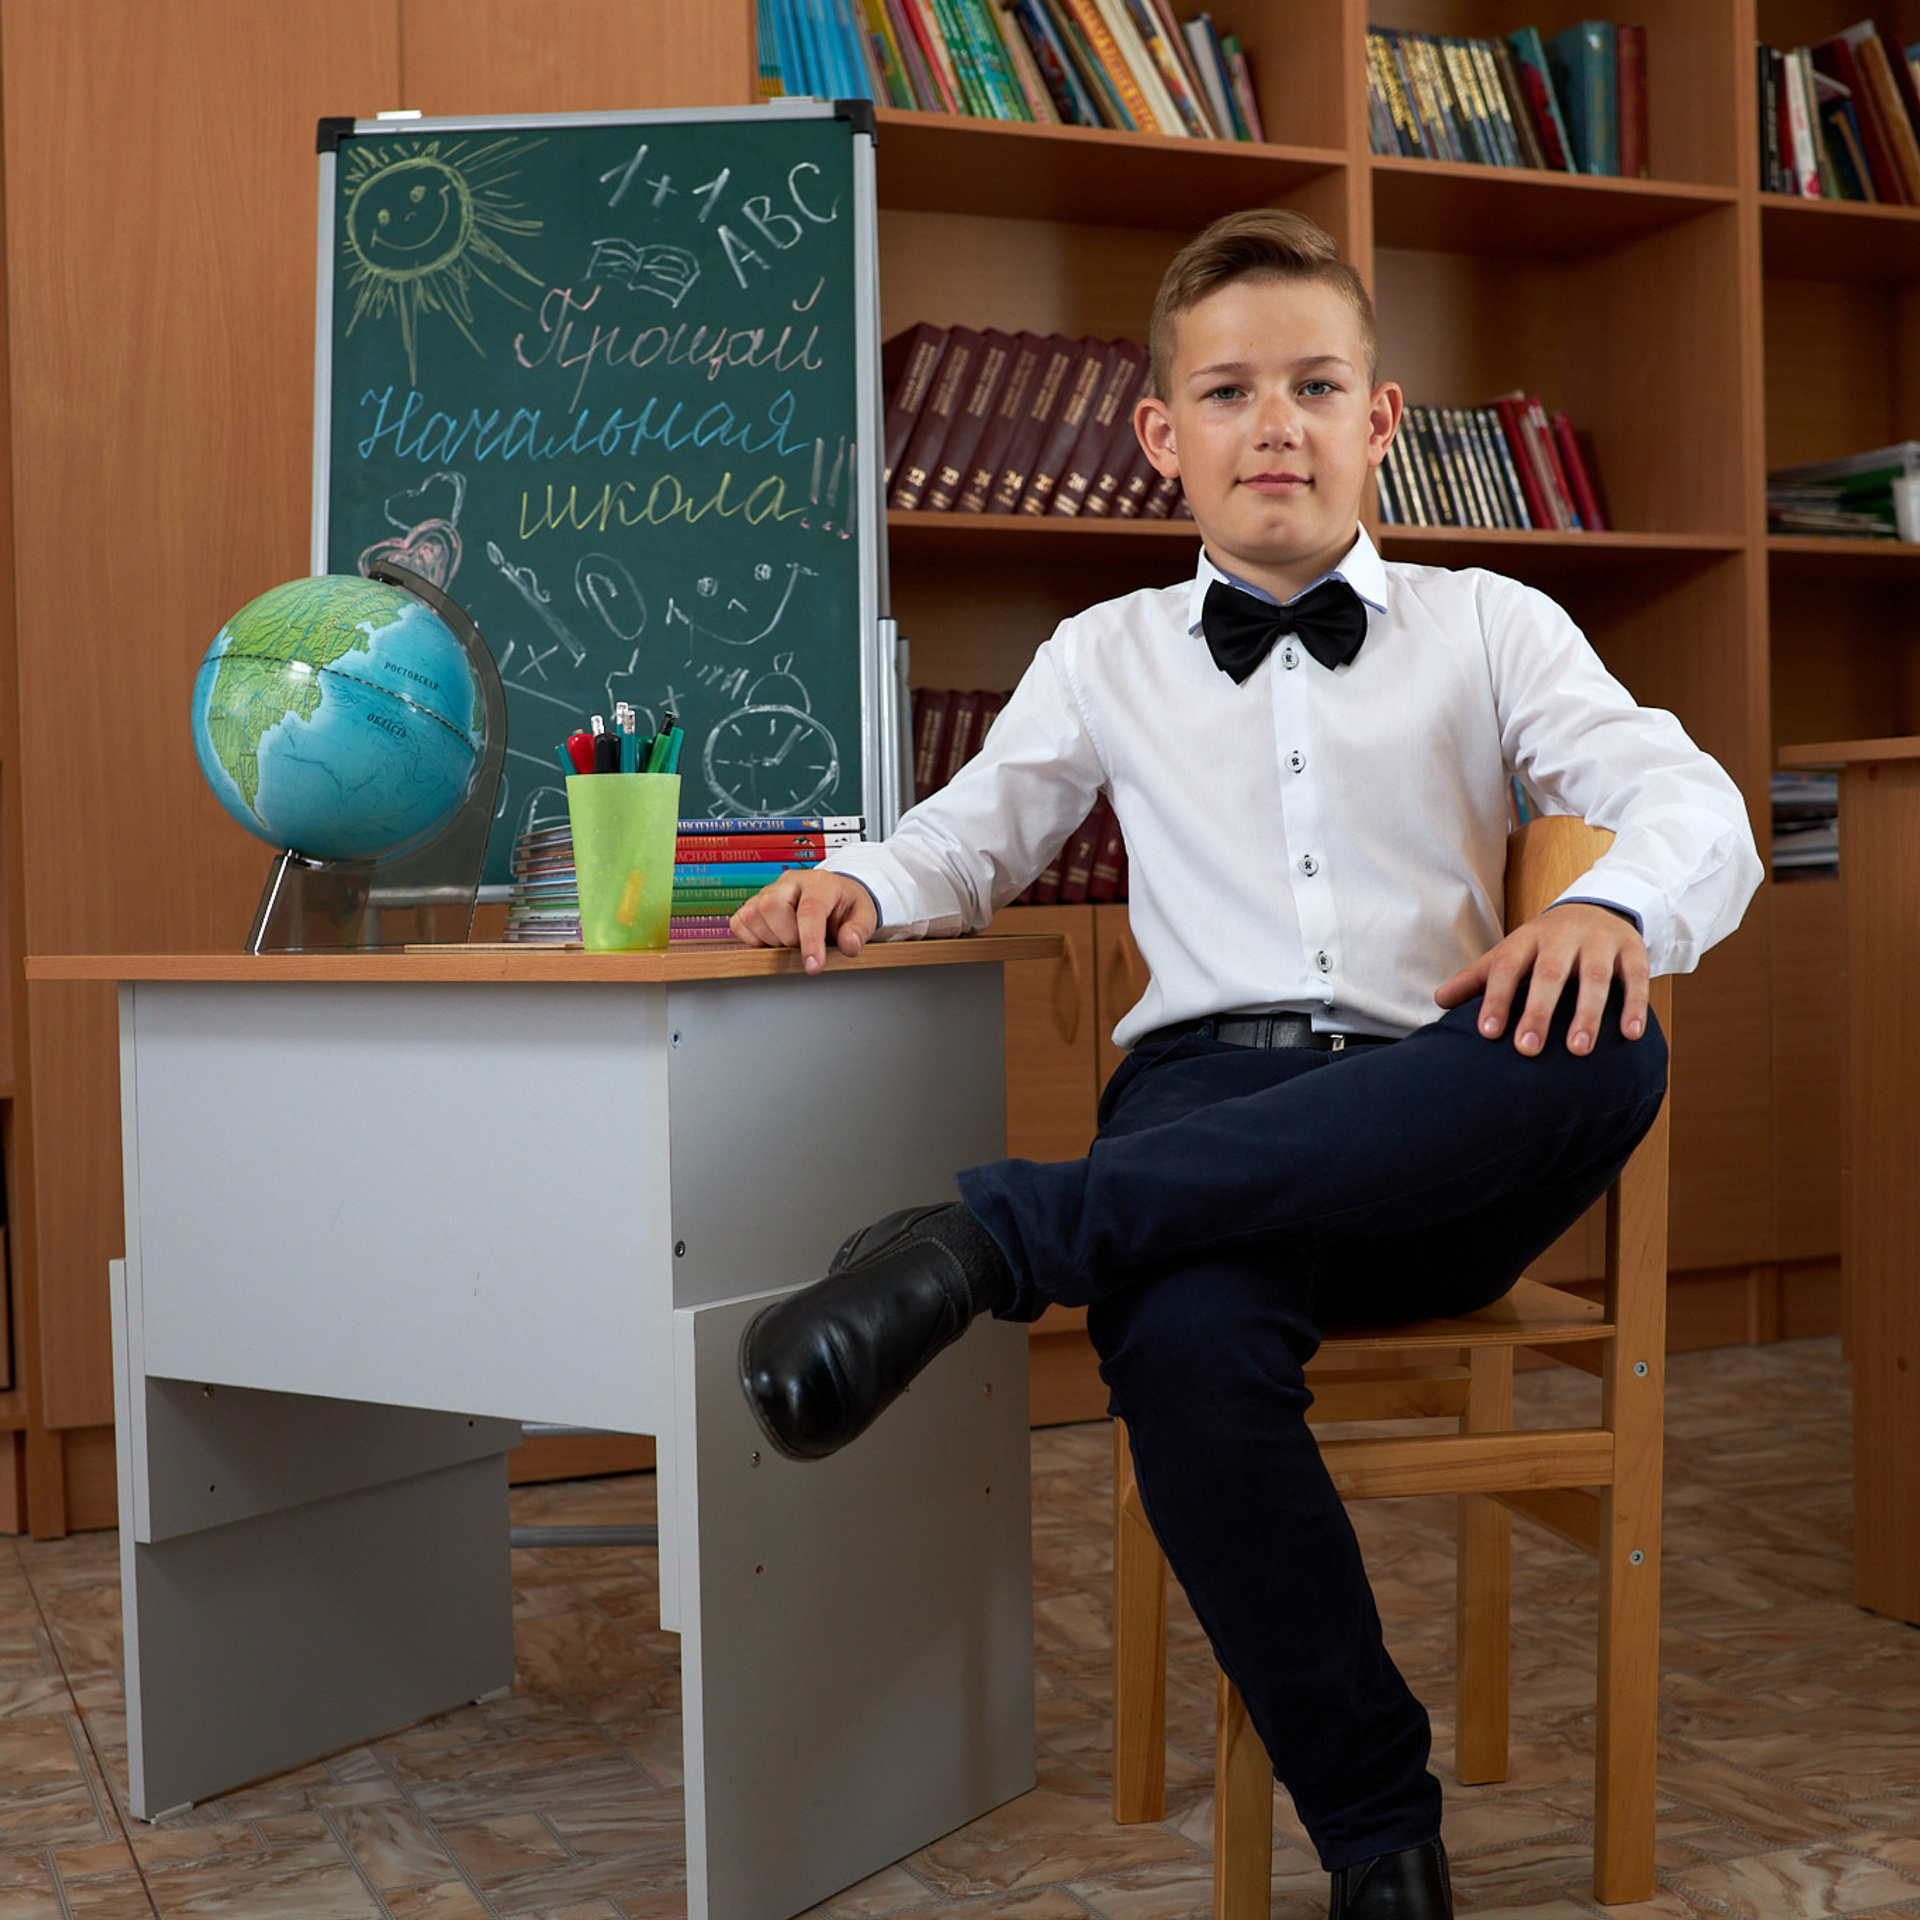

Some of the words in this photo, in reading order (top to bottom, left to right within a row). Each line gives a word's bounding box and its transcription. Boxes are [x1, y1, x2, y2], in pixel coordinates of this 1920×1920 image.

[514, 277, 825, 413] Прощай
[358, 386, 811, 464] Начальная
[383, 661, 440, 691] РОСТОВСКАЯ
[366, 712, 407, 739] ОБЛАСТЬ
[738, 820, 784, 831] РОССИИ
[722, 851, 761, 861] КНИГА
